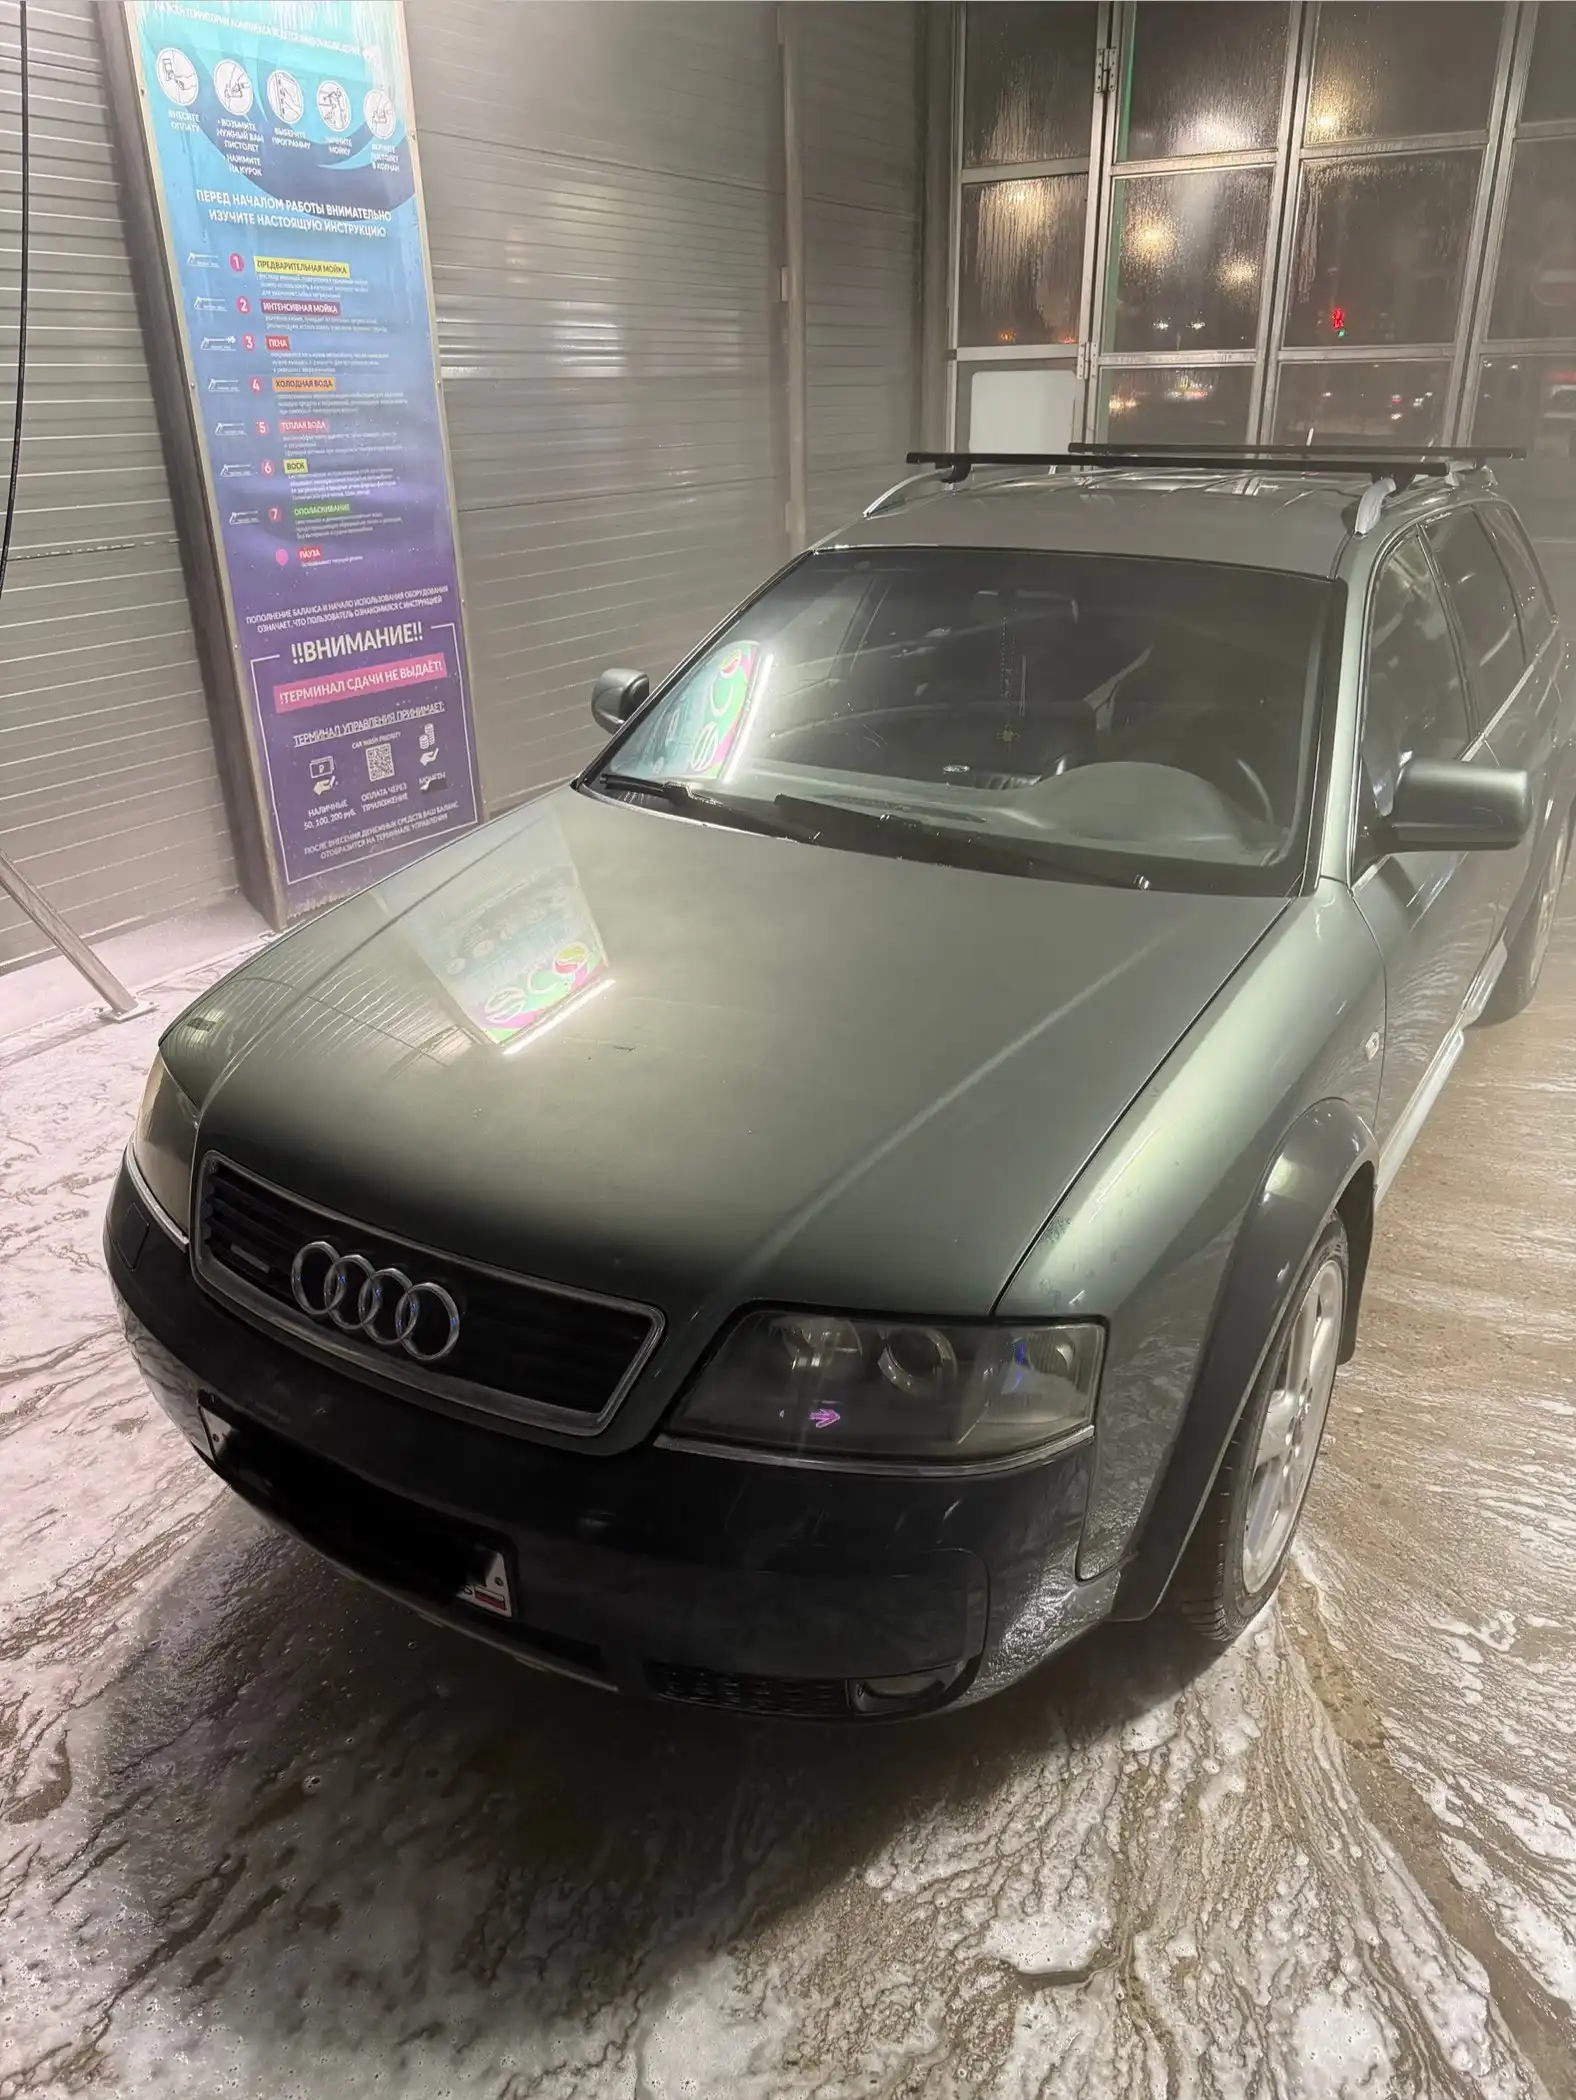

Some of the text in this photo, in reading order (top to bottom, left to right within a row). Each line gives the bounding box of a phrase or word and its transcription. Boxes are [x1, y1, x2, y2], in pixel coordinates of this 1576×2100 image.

[171, 121, 200, 133] ОПЛАТУ
[221, 118, 256, 131] ВОЗЬМИТЕ
[216, 127, 264, 143] НУЖНЫЙ ВАМ
[224, 140, 259, 152] ПИСТОЛЕТ
[272, 137, 311, 150] ПРОГРАММУ
[227, 154, 261, 166] НАЖМИТЕ
[240, 166, 262, 176] КУРОК
[196, 189, 392, 222] ПЕРЕД НАЧАЛОМ РАБОТЫ ВНИМАТЕЛЬНО
[208, 209, 387, 238] ИЗУЧИТЕ НАСТОЯЩУЮ ИНСТРУКЦИЮ
[232, 255, 240, 270] 1
[257, 259, 347, 275] ПРЕДВАРИТЕЛЬНАЯ МОЙКА
[239, 298, 247, 312] 2
[263, 301, 338, 314] ИНТЕНСИВНАЯ МОЙКА
[245, 335, 253, 349] 3
[268, 338, 288, 348] ПЕНА
[252, 379, 260, 391] 4
[275, 380, 333, 389] ХОЛОДНАЯ ВОДА
[259, 421, 266, 434] 5
[281, 420, 326, 430] ТЕПЛАЯ ВОДА
[264, 462, 272, 474] 6
[286, 462, 305, 471] ВОСК
[272, 508, 278, 520] 7
[294, 504, 350, 516] ОПОЛАСКИВАНИЕ
[299, 549, 320, 559] ПАУЗА
[246, 608, 292, 625] ПОПОЛНЕНИЕ
[292, 605, 322, 618] БАЛАНСА
[328, 600, 353, 612] НАЧАЛО
[354, 592, 404, 608] ИСПОЛЬЗОВАНИЯ
[404, 585, 449, 600] ОБОРУДОВАНИЯ
[257, 620, 293, 633] ОЗНАЧАЕТ,
[294, 617, 307, 627] ЧТО
[307, 610, 354, 625] ПОЛЬЗОВАТЕЛЬ
[354, 603, 399, 618] ОЗНАКОМИЛСЯ
[404, 595, 442, 609] ИНСТРУКЦИЕЙ
[291, 621, 424, 665] !!ВНИМАНИЕ!!
[279, 660, 442, 705] !ТЕРМИНАЛ СДАЧИ НЕ ВЫДАЁТ!
[293, 701, 445, 747] ТЕРМИНАЛ УПРАВЛЕНИЯ ПРИНИМАЕТ:
[361, 788, 388, 802] ОПЛАТА
[308, 799, 349, 818] НАЛИЧНЫЕ
[331, 812, 343, 823] 200
[304, 842, 327, 855] ПОСЛЕ
[327, 832, 360, 848] ВНЕСЕНИЯ
[397, 812, 422, 827] СРЕДСТВ
[422, 807, 436, 818] ВАШ
[436, 801, 459, 814] БАЛАНС
[320, 840, 365, 860] ОТОБРАЗИТСЯ
[365, 836, 375, 846] НА
[411, 813, 448, 832] УПРАВЛЕНИЯ
